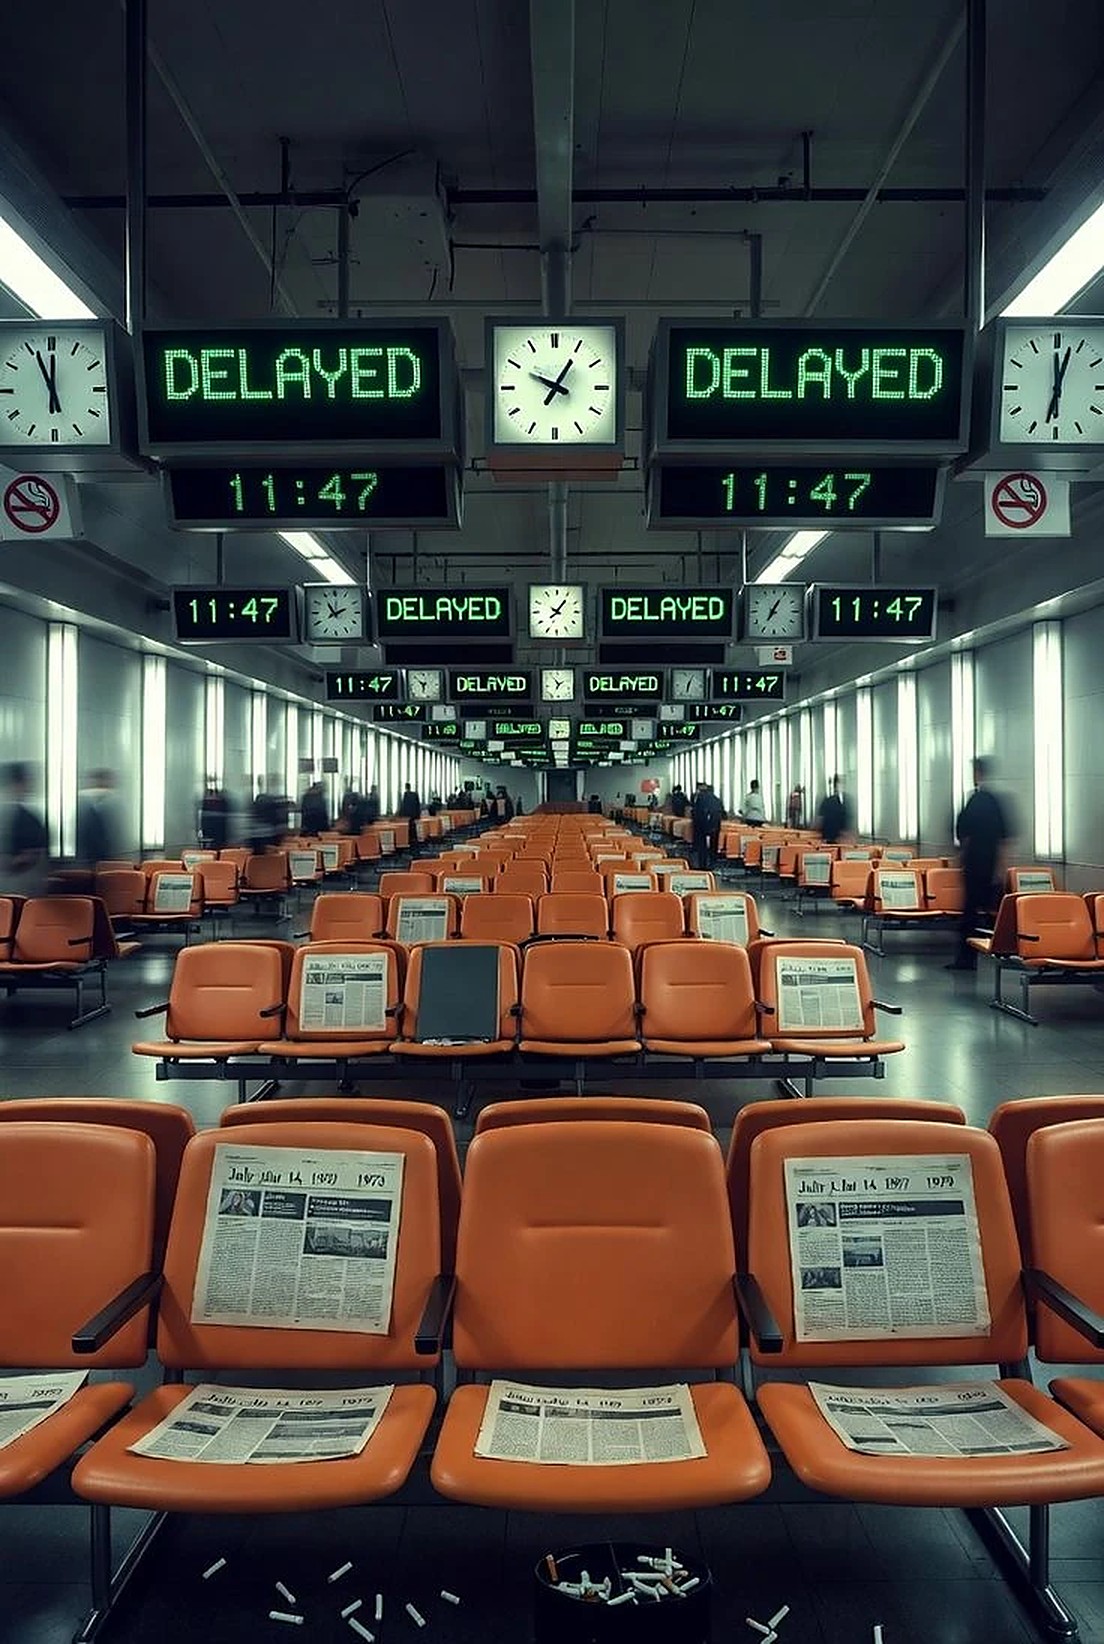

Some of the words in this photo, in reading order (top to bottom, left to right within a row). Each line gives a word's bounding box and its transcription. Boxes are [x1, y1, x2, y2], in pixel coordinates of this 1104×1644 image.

[164, 347, 421, 401] DELAYED
[685, 347, 943, 400] DELAYED
[229, 473, 377, 512] 11:47
[722, 473, 871, 510] 11:47
[188, 597, 278, 623] 11:47
[386, 596, 502, 621] DELAYED
[611, 596, 725, 621] DELAYED
[832, 596, 923, 622] 11:47
[335, 676, 393, 693] 11:47
[723, 676, 779, 693] 11:47
